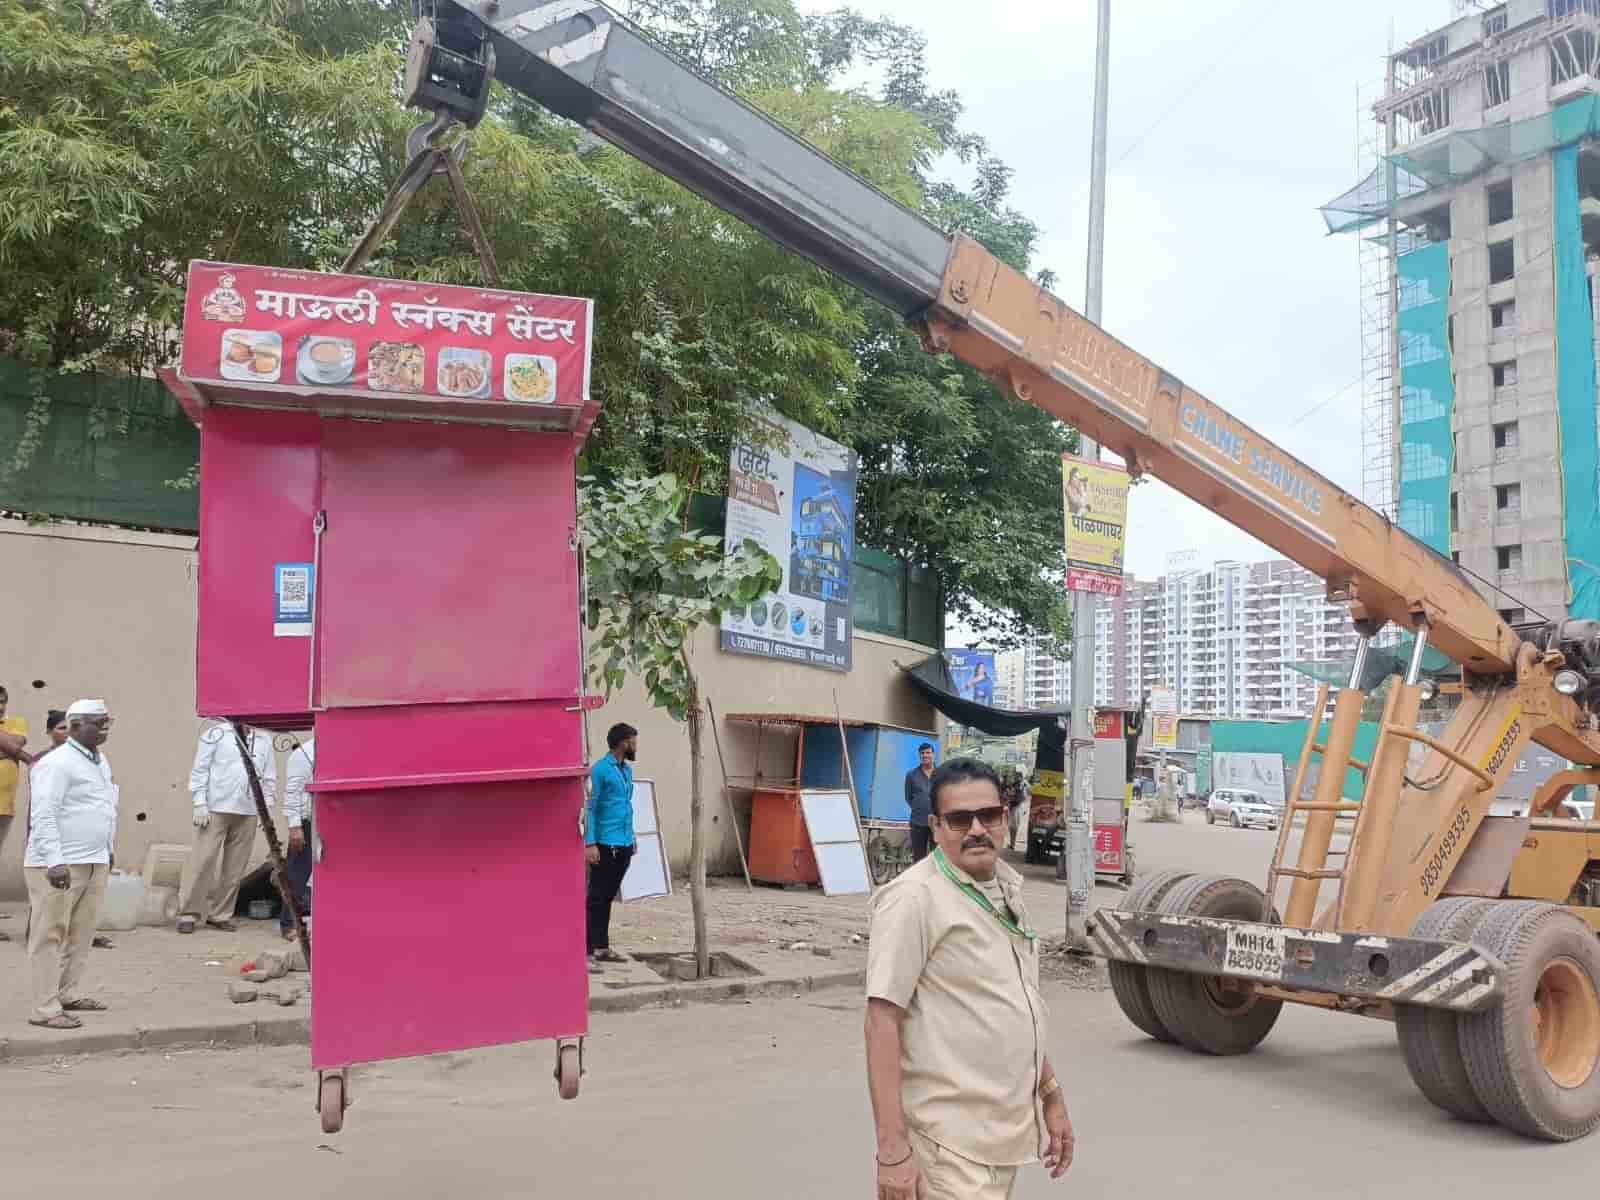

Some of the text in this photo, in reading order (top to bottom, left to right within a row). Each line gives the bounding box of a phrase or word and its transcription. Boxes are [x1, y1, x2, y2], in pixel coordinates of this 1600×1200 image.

[255, 288, 577, 344] माऊली स्नॅक्स सेंटर
[1183, 402, 1322, 513] CRANE SERVICE
[1235, 932, 1276, 953] MH14
